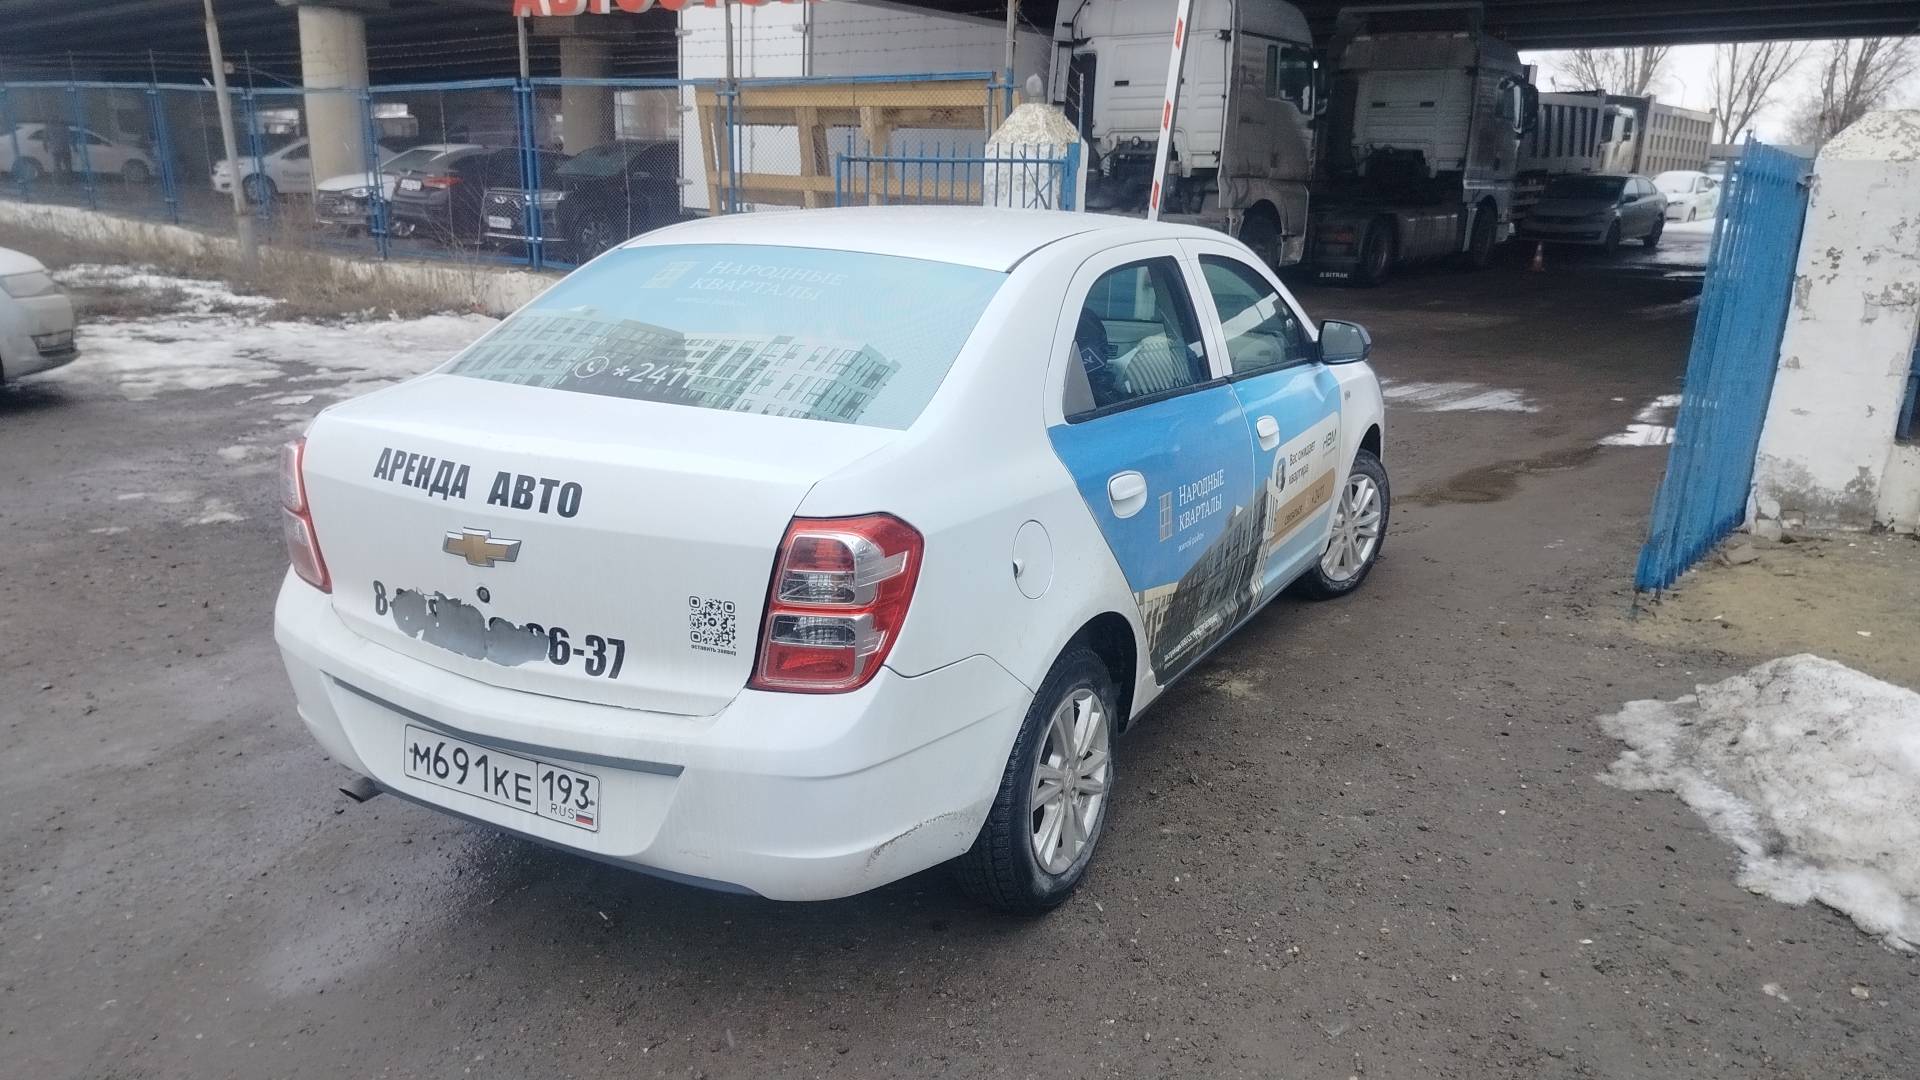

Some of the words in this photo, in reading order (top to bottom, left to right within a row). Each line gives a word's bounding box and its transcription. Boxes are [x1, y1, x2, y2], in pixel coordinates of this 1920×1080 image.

[689, 277, 821, 301] КВАРТАЛЫ
[708, 261, 848, 286] НАРОДНЫЕ
[373, 447, 471, 500] АРЕНДА
[487, 471, 583, 518] АВТО
[1178, 468, 1224, 507] НАРОДНЫЕ
[1178, 493, 1222, 532] КВАРТАЛЫ
[413, 741, 532, 806] М691КЕ
[541, 770, 590, 810] 193
[550, 803, 576, 820] RUS
